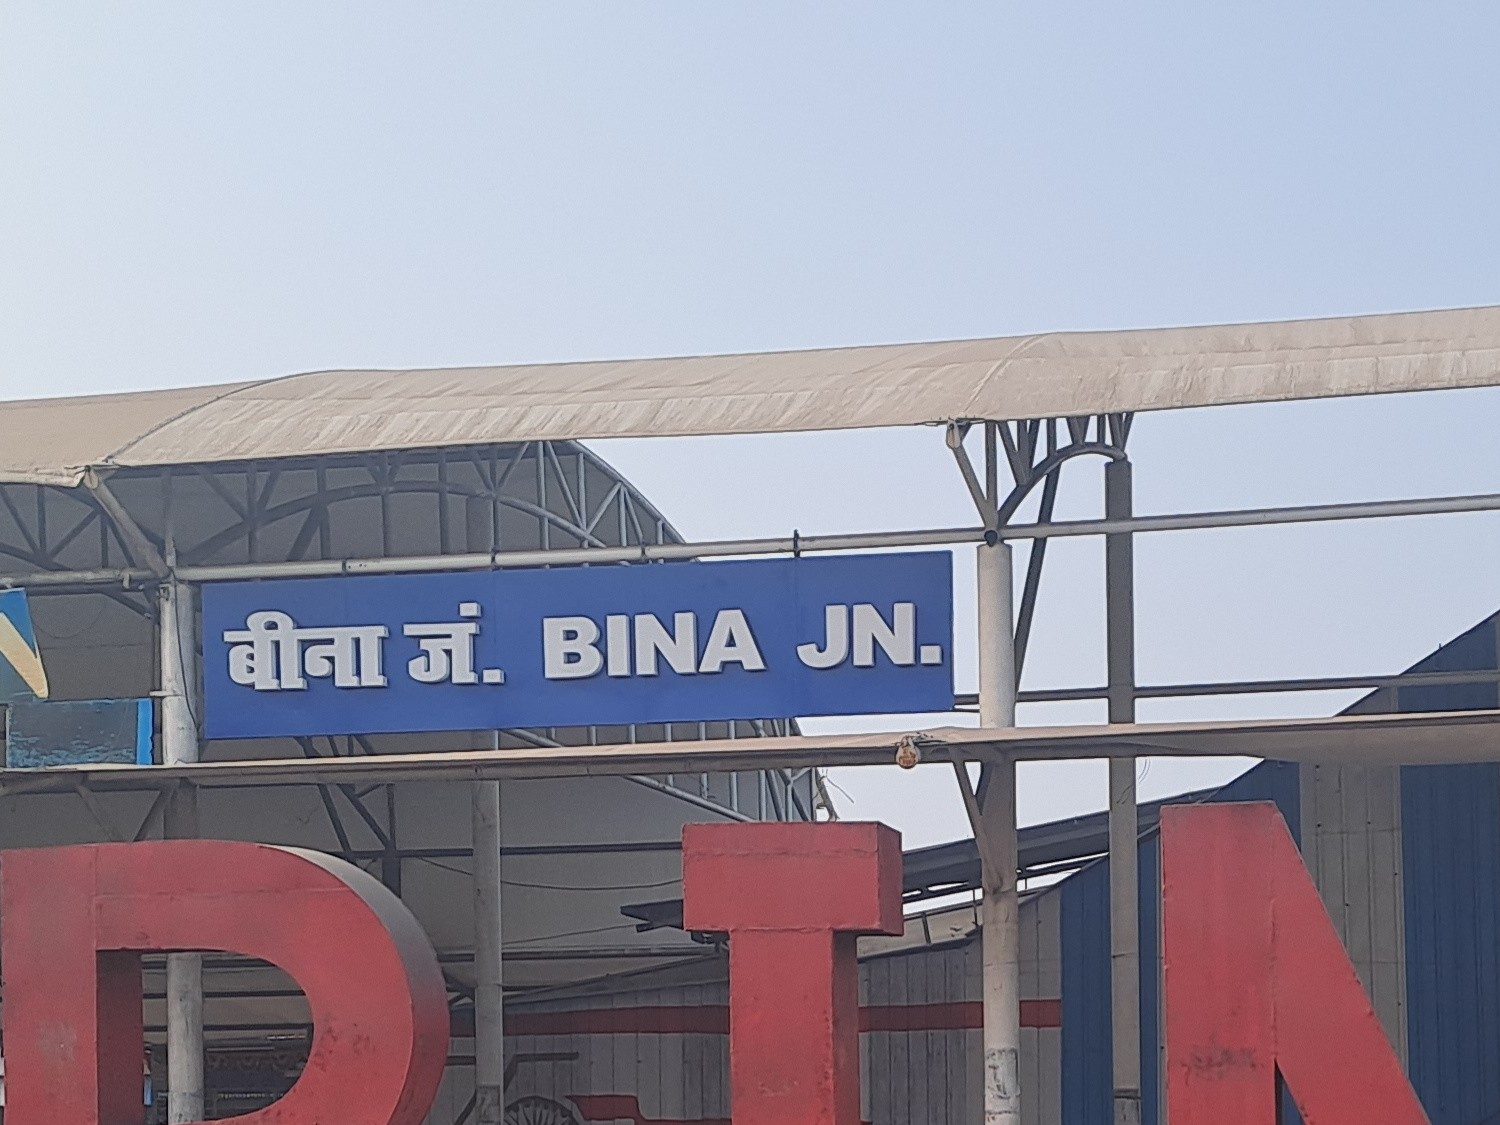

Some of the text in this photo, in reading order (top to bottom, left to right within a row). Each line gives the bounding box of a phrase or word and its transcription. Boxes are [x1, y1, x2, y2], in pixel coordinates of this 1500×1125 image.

[223, 602, 505, 690] बीना जं.
[543, 603, 943, 680] BINA JN.
